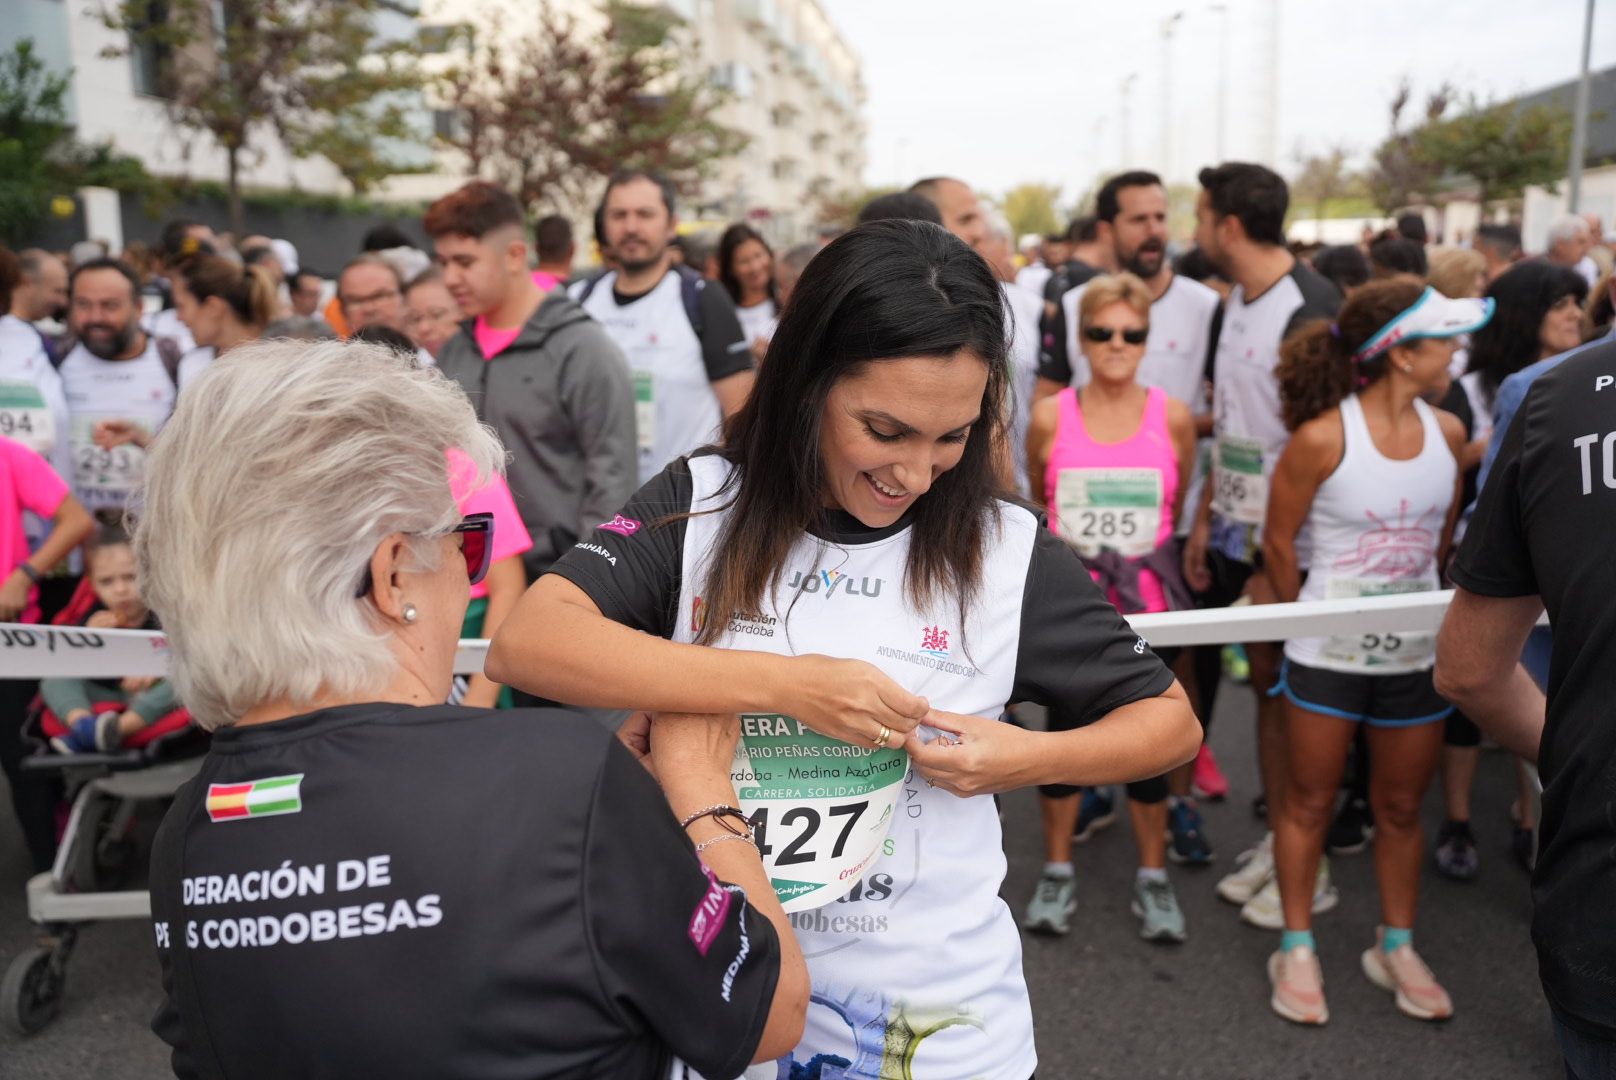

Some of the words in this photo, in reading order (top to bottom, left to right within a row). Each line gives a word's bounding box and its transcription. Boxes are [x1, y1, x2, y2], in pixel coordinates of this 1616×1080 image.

[1081, 511, 1136, 538] 285
[788, 569, 881, 600] JOYLU
[727, 620, 775, 638] Córdoba
[876, 646, 936, 669] AYUNTAMIENTO
[936, 660, 945, 672] DE
[740, 717, 791, 737] ERA
[776, 744, 821, 758] PEÑAS
[823, 746, 880, 758] CORDO
[788, 766, 840, 780] Medina
[845, 758, 901, 778] Azahara
[744, 787, 802, 799] CARRERA
[807, 783, 876, 798] SOLIDARIA
[747, 800, 869, 867] 427
[182, 859, 326, 906] DERACIÓN
[336, 854, 392, 893] DE
[201, 893, 444, 950] CORDOBESAS
[720, 934, 750, 1003] MEDINA
